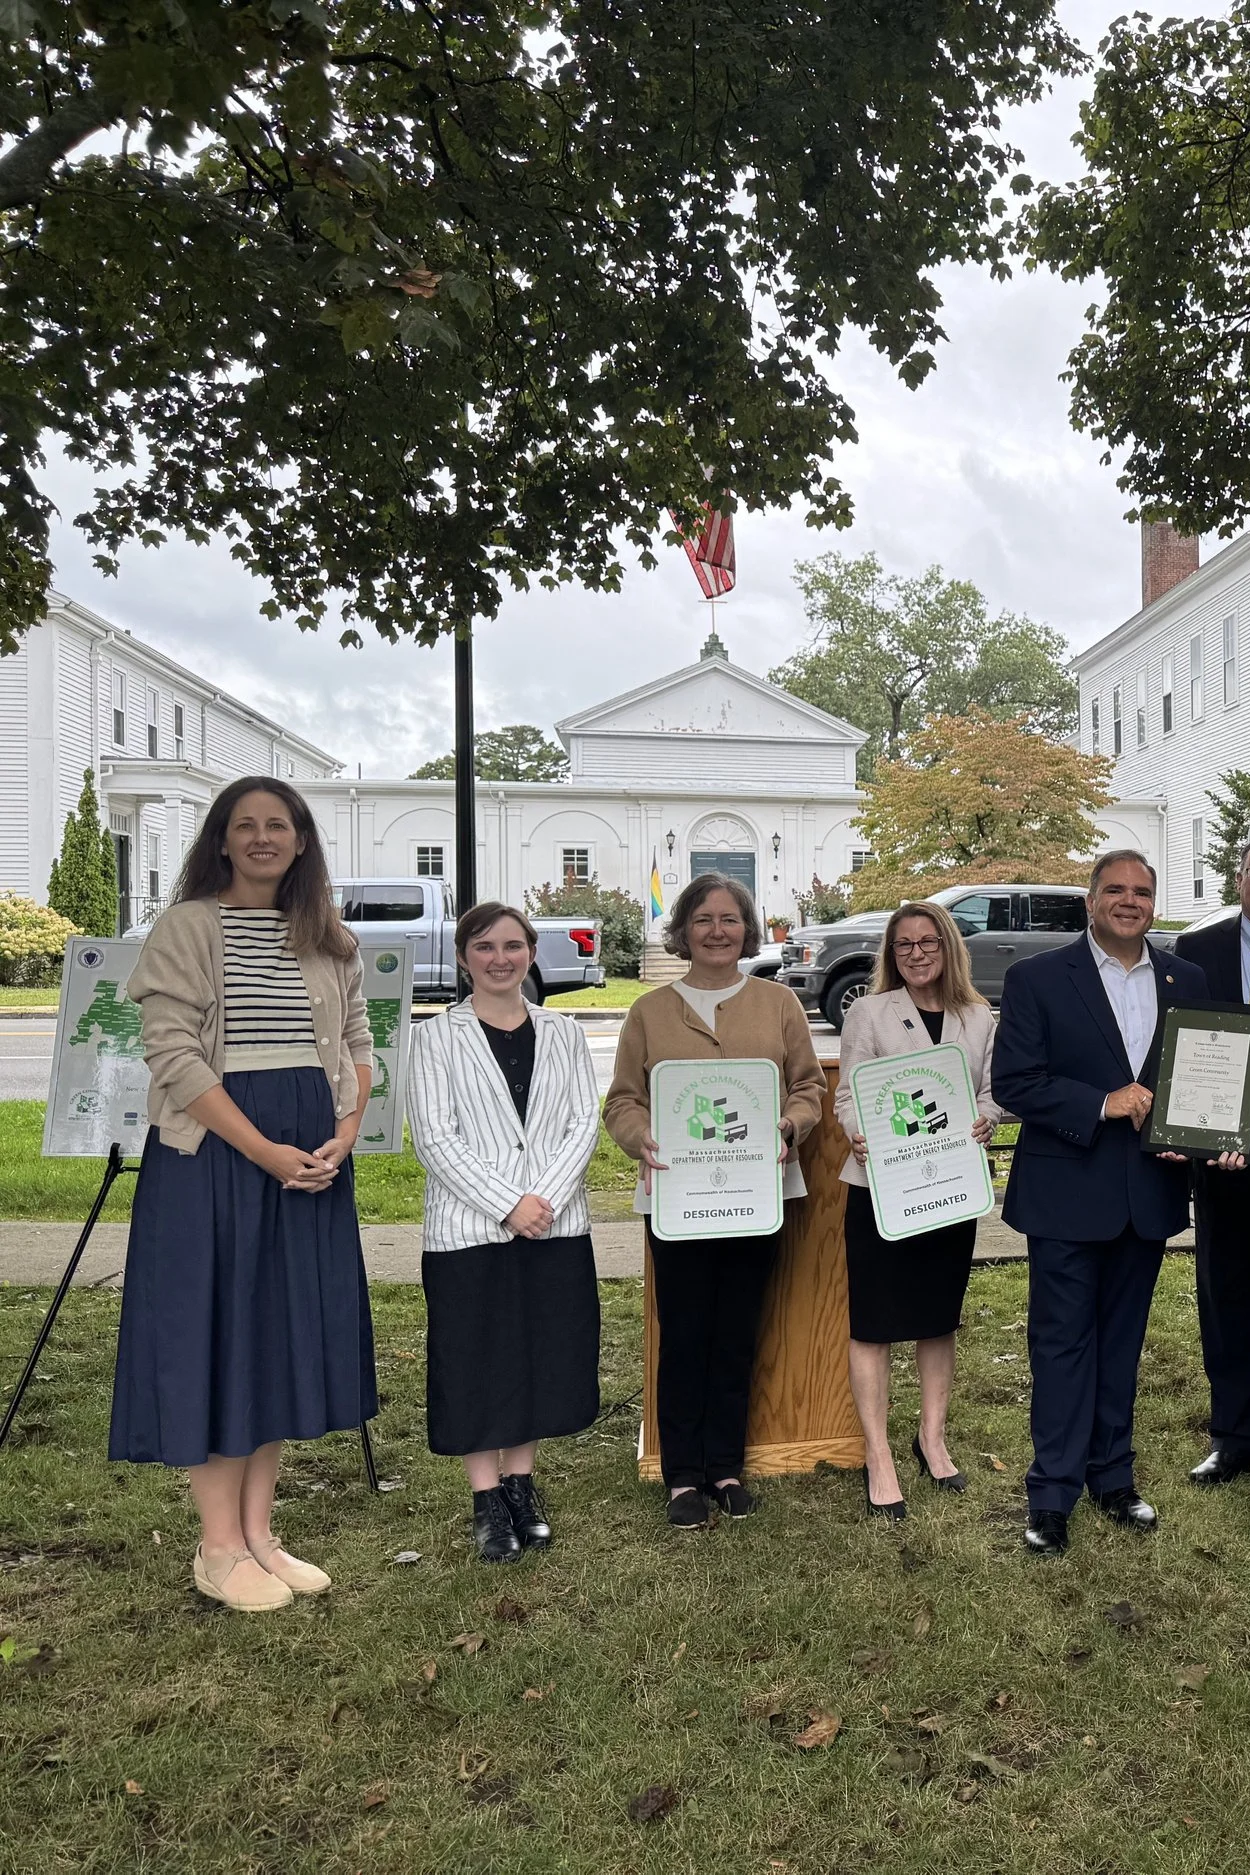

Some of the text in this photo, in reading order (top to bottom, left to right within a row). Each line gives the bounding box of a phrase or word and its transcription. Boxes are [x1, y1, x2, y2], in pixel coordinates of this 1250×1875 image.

[673, 1075, 761, 1114] GREEN COMMUNITY
[875, 1067, 957, 1115] GREEN COMMUNITY
[884, 1153, 914, 1165] DEPARTMENT
[923, 1146, 940, 1157] ENERGY
[941, 1140, 967, 1152] RESOURCES
[898, 1138, 950, 1154] Massachusetts
[672, 1156, 704, 1164] DEPARTMENT
[715, 1154, 734, 1162] ENERGY
[736, 1154, 764, 1162] RESOURCES
[684, 1208, 754, 1219] DESIGNATED
[904, 1193, 968, 1216] DESIGNATED
